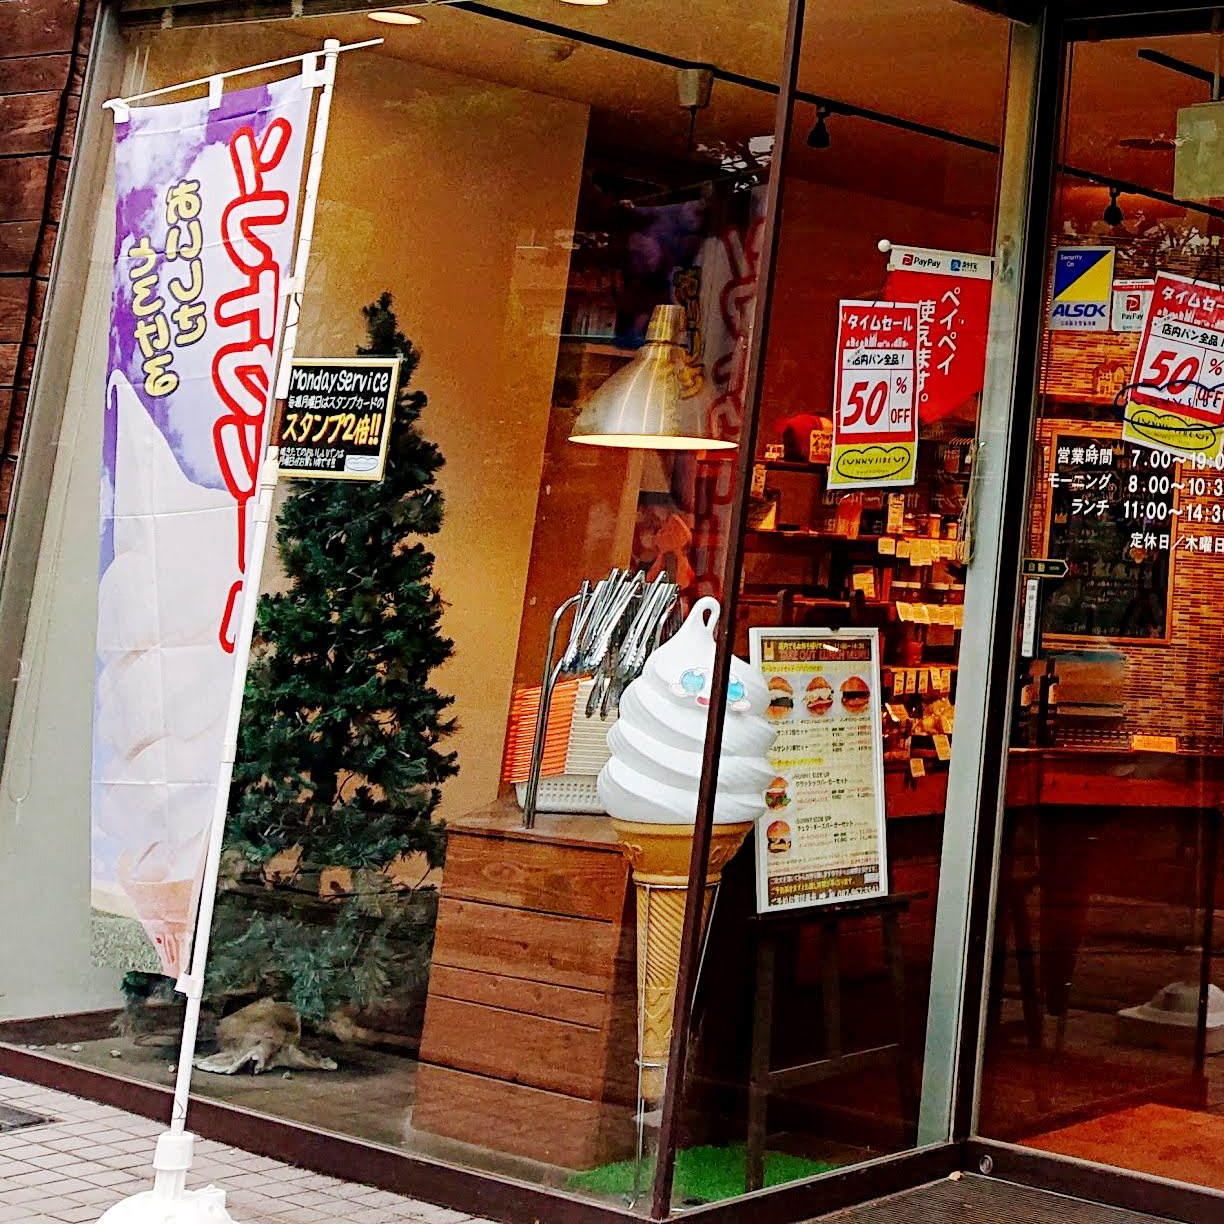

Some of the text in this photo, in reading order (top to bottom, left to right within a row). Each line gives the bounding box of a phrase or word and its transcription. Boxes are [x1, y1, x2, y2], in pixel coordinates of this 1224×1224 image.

[914, 257, 941, 268] PayPay
[1052, 304, 1107, 317] ALSOK
[1121, 313, 1143, 321] PayPay
[847, 314, 913, 332] タイムセール
[936, 287, 961, 376] ペイペイ
[1142, 350, 1199, 395] 50
[1208, 358, 1224, 377] %
[895, 376, 908, 394] %
[842, 380, 888, 427] 50
[1197, 388, 1224, 404] OFF
[890, 408, 911, 424] OFF
[282, 412, 383, 446] スタンプ2倍!!
[842, 457, 874, 466] SUNNY
[875, 456, 891, 464] SIDE
[1057, 445, 1113, 466] 営業時間
[1047, 472, 1112, 491] モーニング
[1071, 497, 1110, 517] ランチ
